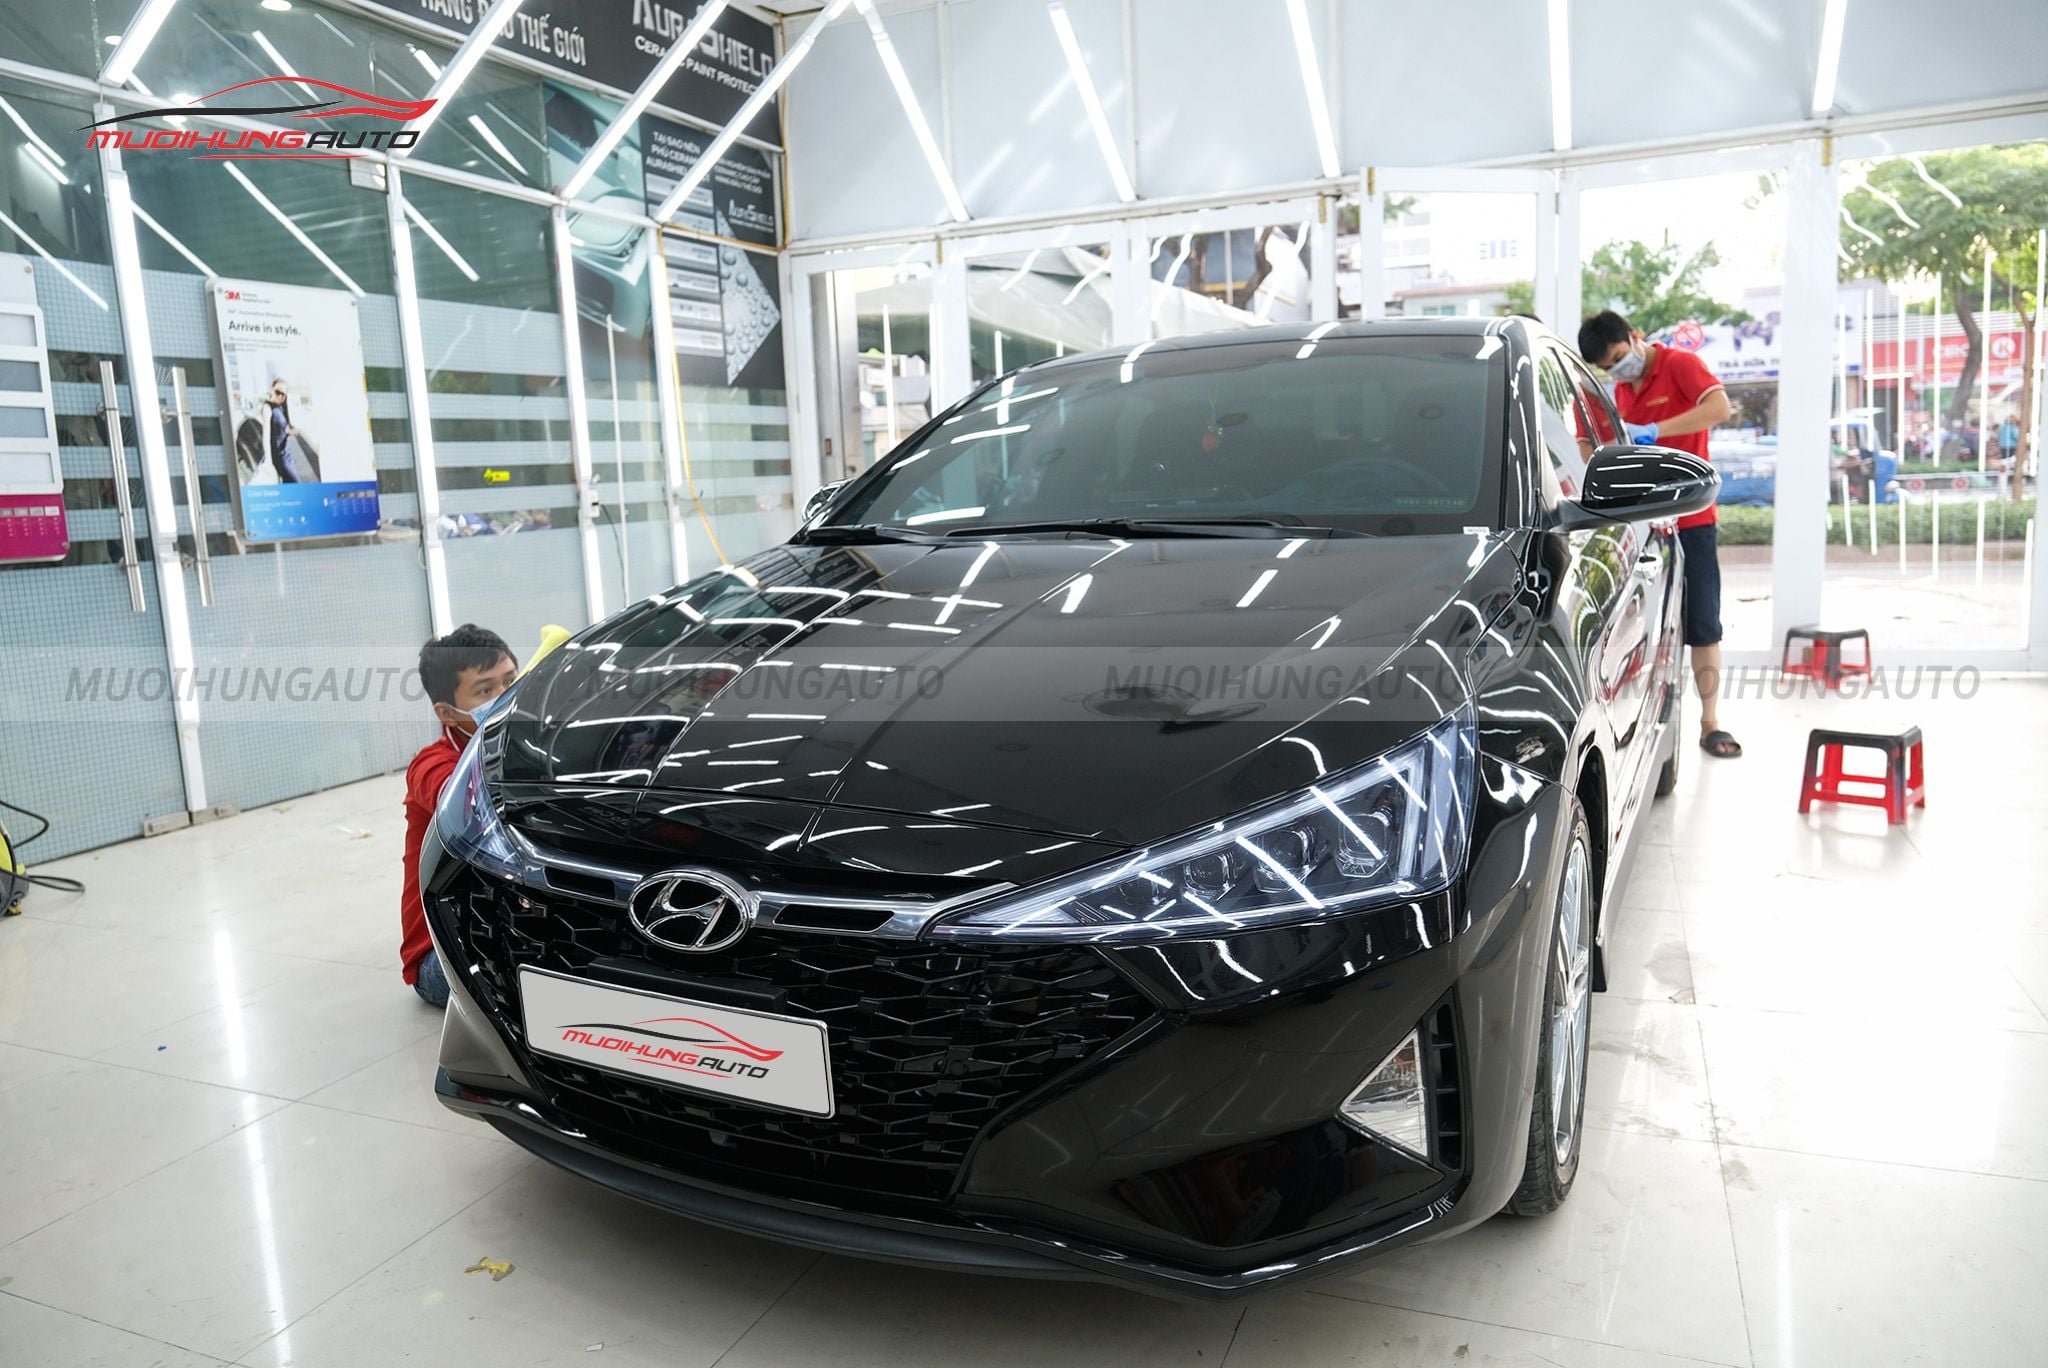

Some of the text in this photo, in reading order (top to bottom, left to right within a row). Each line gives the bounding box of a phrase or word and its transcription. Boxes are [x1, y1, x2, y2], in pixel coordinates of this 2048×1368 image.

[517, 12, 551, 53] THẾ
[553, 26, 587, 66] GIỚI
[632, 0, 776, 82] AURSHIELD
[685, 57, 717, 82] PAINT
[228, 320, 302, 337] Arrive in style.
